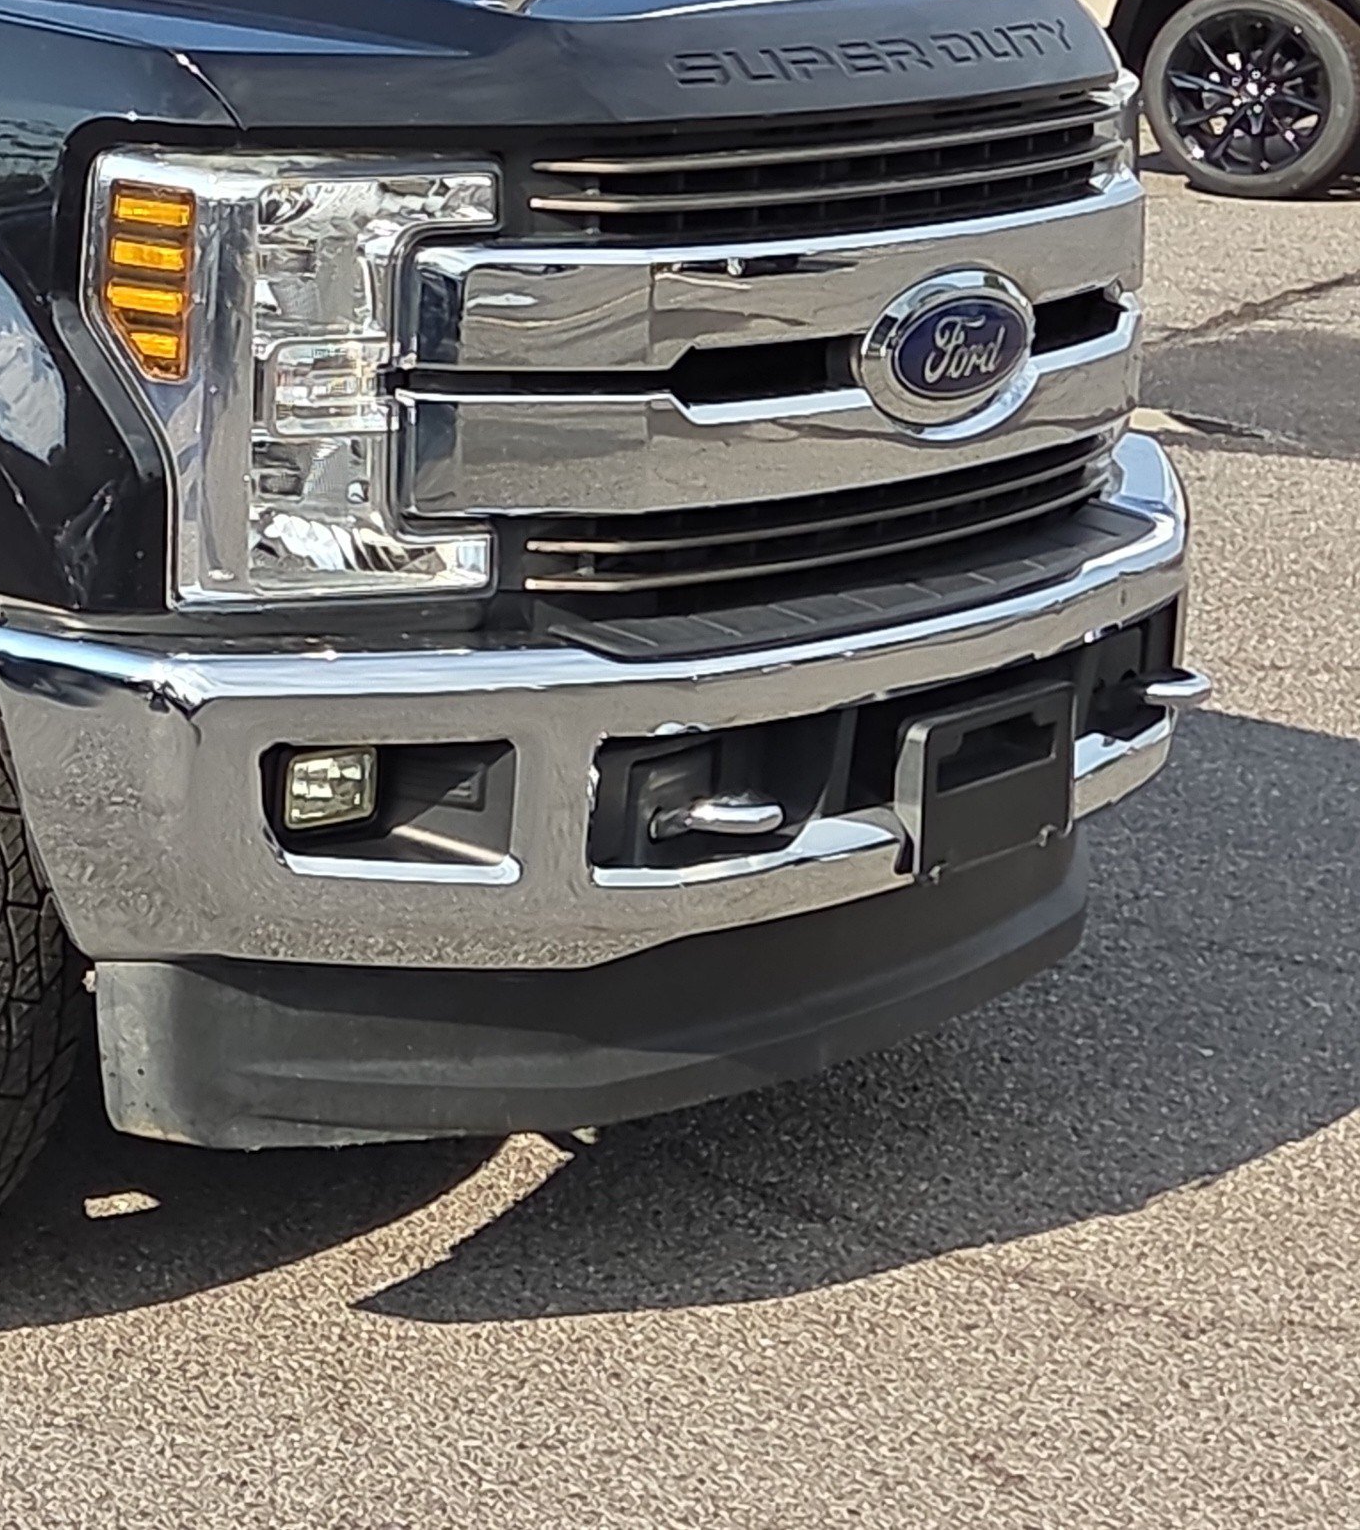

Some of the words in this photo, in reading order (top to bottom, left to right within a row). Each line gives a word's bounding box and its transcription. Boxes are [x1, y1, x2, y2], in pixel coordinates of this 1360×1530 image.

[671, 37, 933, 88] SUPER
[930, 19, 1072, 64] DUTY
[923, 314, 1006, 384] Ford
